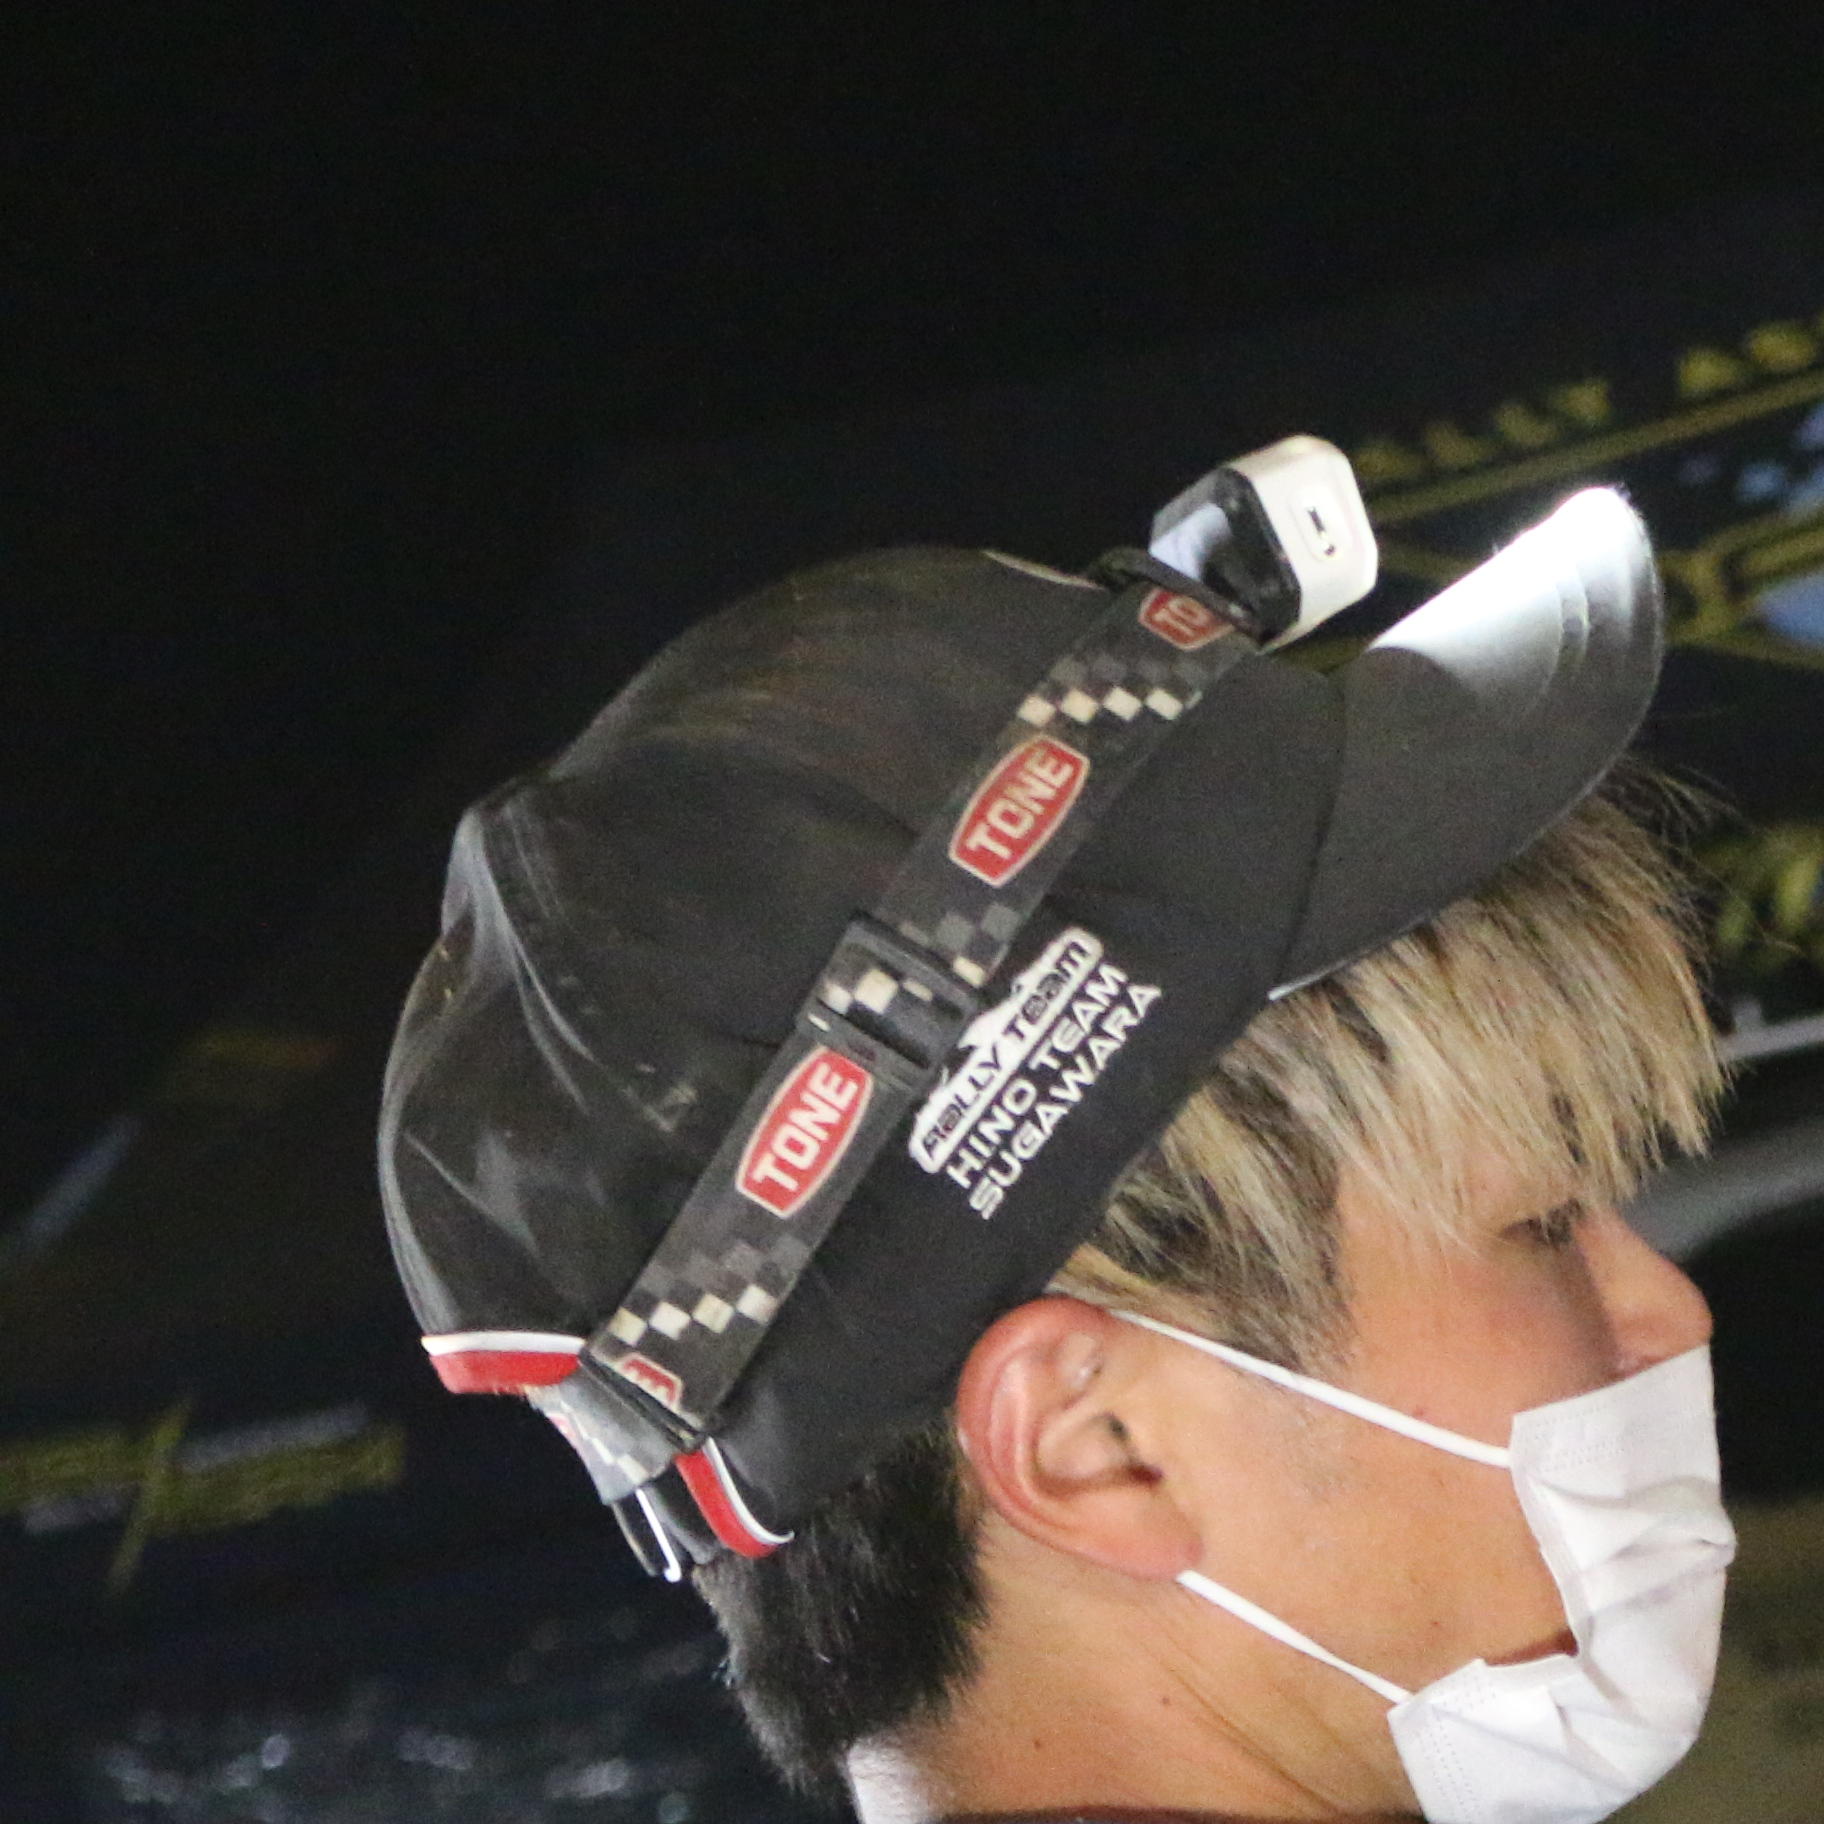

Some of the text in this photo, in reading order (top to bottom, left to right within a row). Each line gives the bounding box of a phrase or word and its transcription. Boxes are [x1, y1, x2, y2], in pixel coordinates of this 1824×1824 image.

[1154, 594, 1211, 638] TO
[966, 753, 1083, 863] TONE
[751, 1062, 861, 1196] TONE
[946, 962, 1129, 1189] HINO TEAM
[968, 984, 1163, 1220] SUGAWARA
